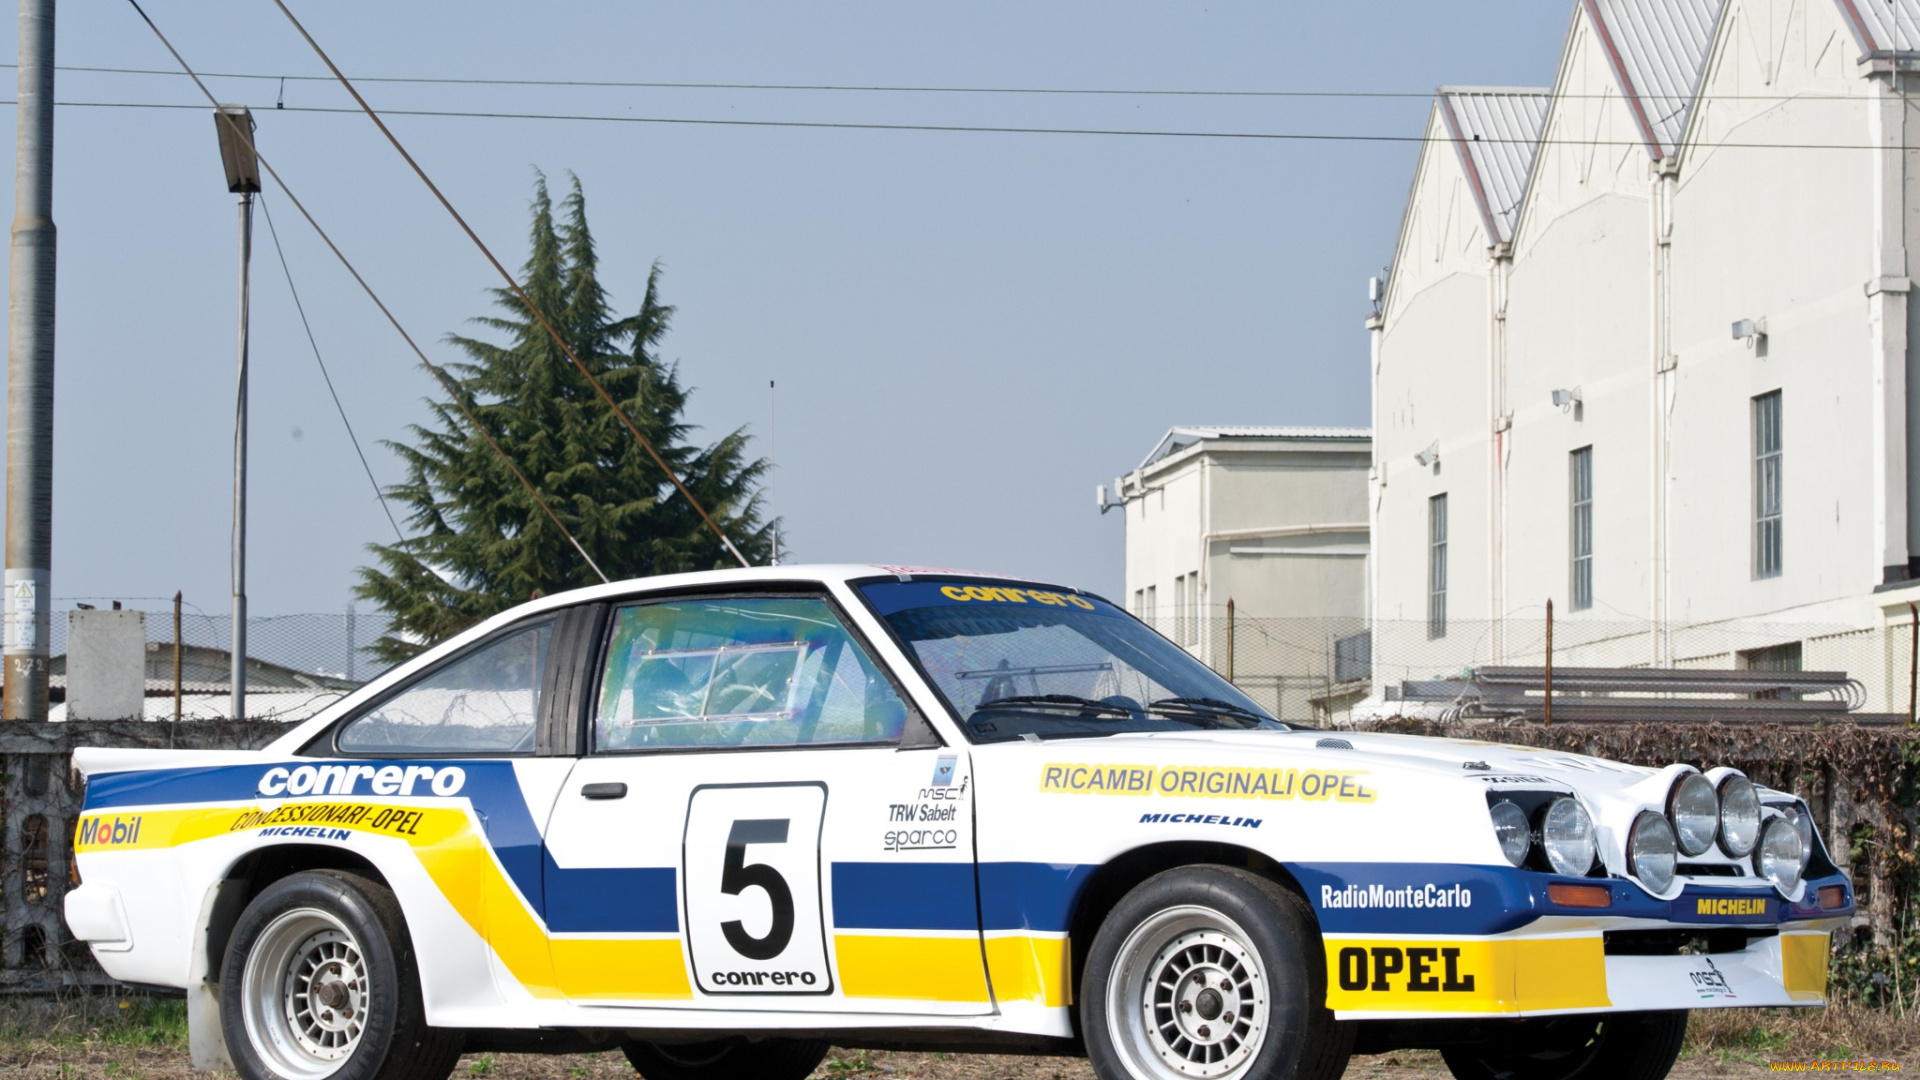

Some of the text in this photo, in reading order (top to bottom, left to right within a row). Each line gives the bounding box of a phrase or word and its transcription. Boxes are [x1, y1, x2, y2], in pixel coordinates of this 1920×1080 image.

[940, 586, 1095, 610] conrero
[258, 764, 466, 796] conrero
[1043, 766, 1372, 798] RICAMBI ORIGINALI OPEL
[230, 804, 424, 836] CONCESSIONARI-OPEL
[889, 804, 956, 821] TRW Sabelt
[1139, 814, 1263, 829] MICHELIN
[78, 816, 140, 845] Mobil
[258, 827, 352, 841] MICHELIN
[884, 829, 957, 852] sparco
[720, 818, 795, 960] 5
[1321, 884, 1471, 908] RadioMonteCarlo
[1697, 899, 1766, 915] MICHELIN
[712, 971, 816, 985] conrero
[1339, 947, 1475, 992] OPEL
